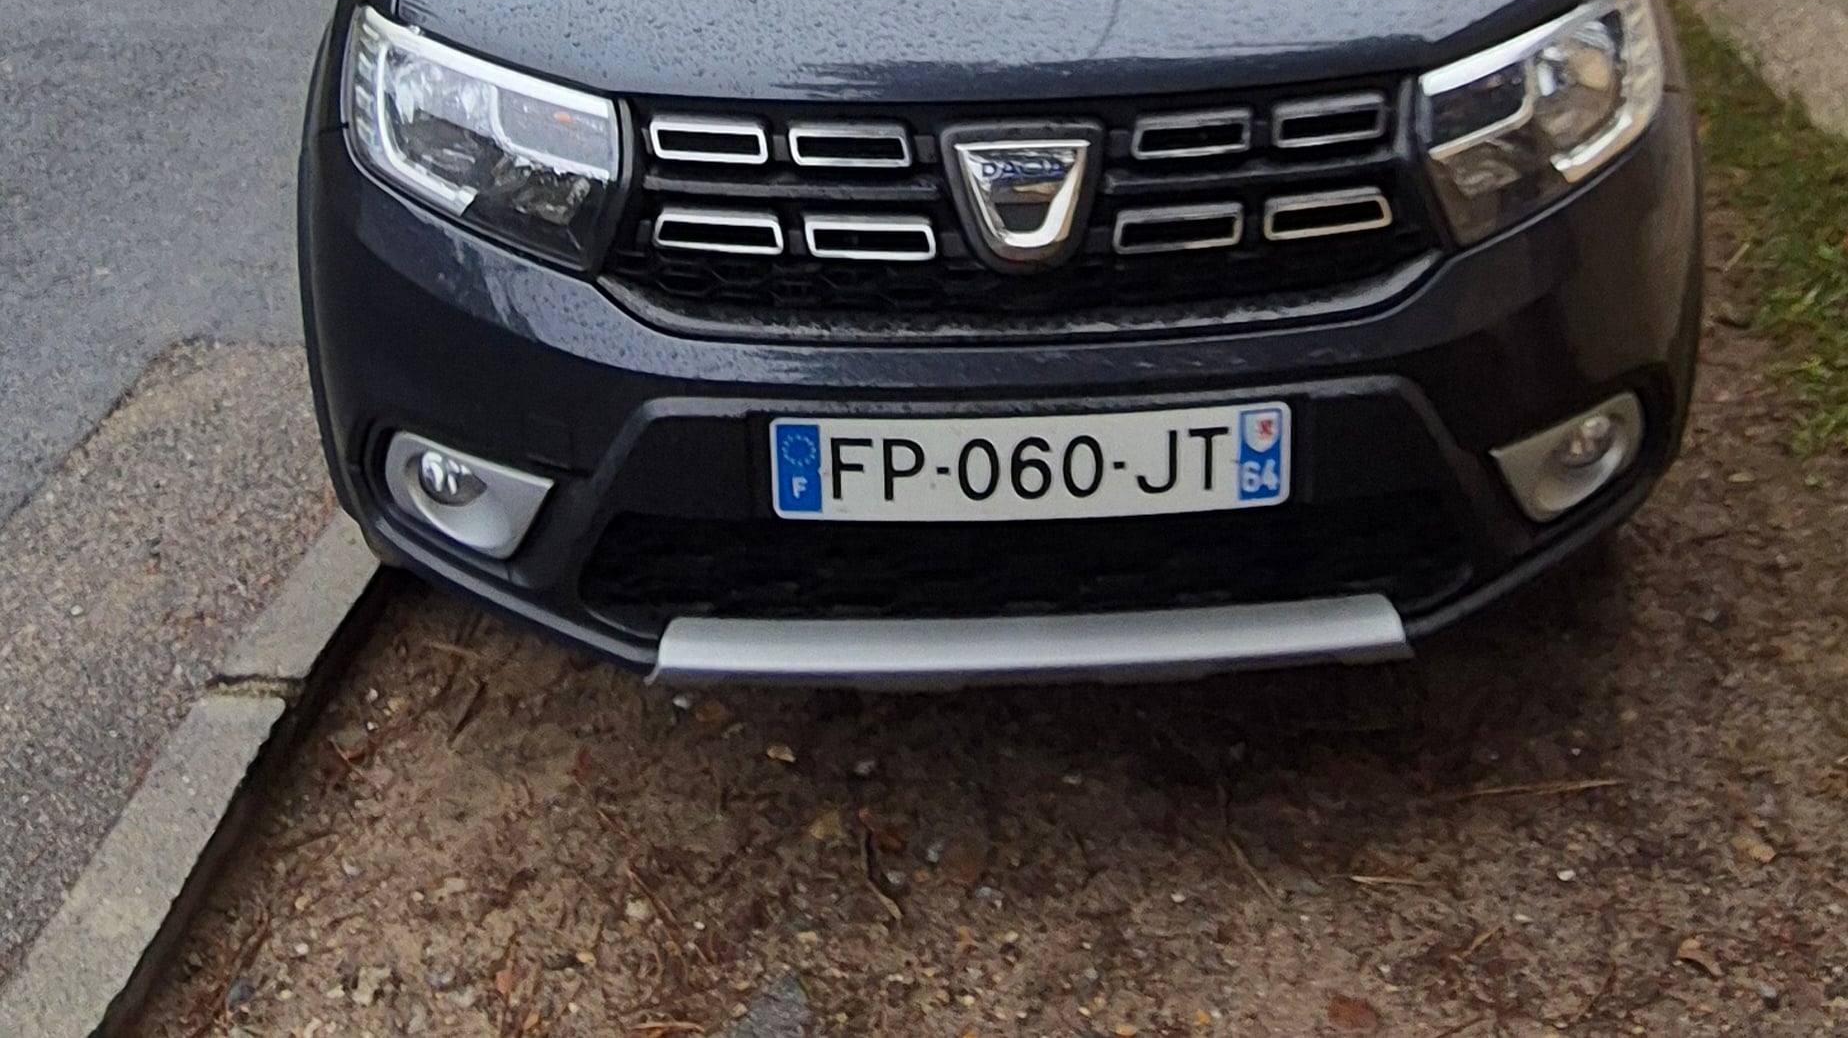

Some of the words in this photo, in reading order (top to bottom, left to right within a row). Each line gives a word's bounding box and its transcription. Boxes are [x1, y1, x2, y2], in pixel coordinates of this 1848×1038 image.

[982, 160, 1066, 179] DACIA
[830, 426, 1230, 501] FP-060-JT
[1240, 459, 1280, 494] 64
[792, 477, 808, 499] F
